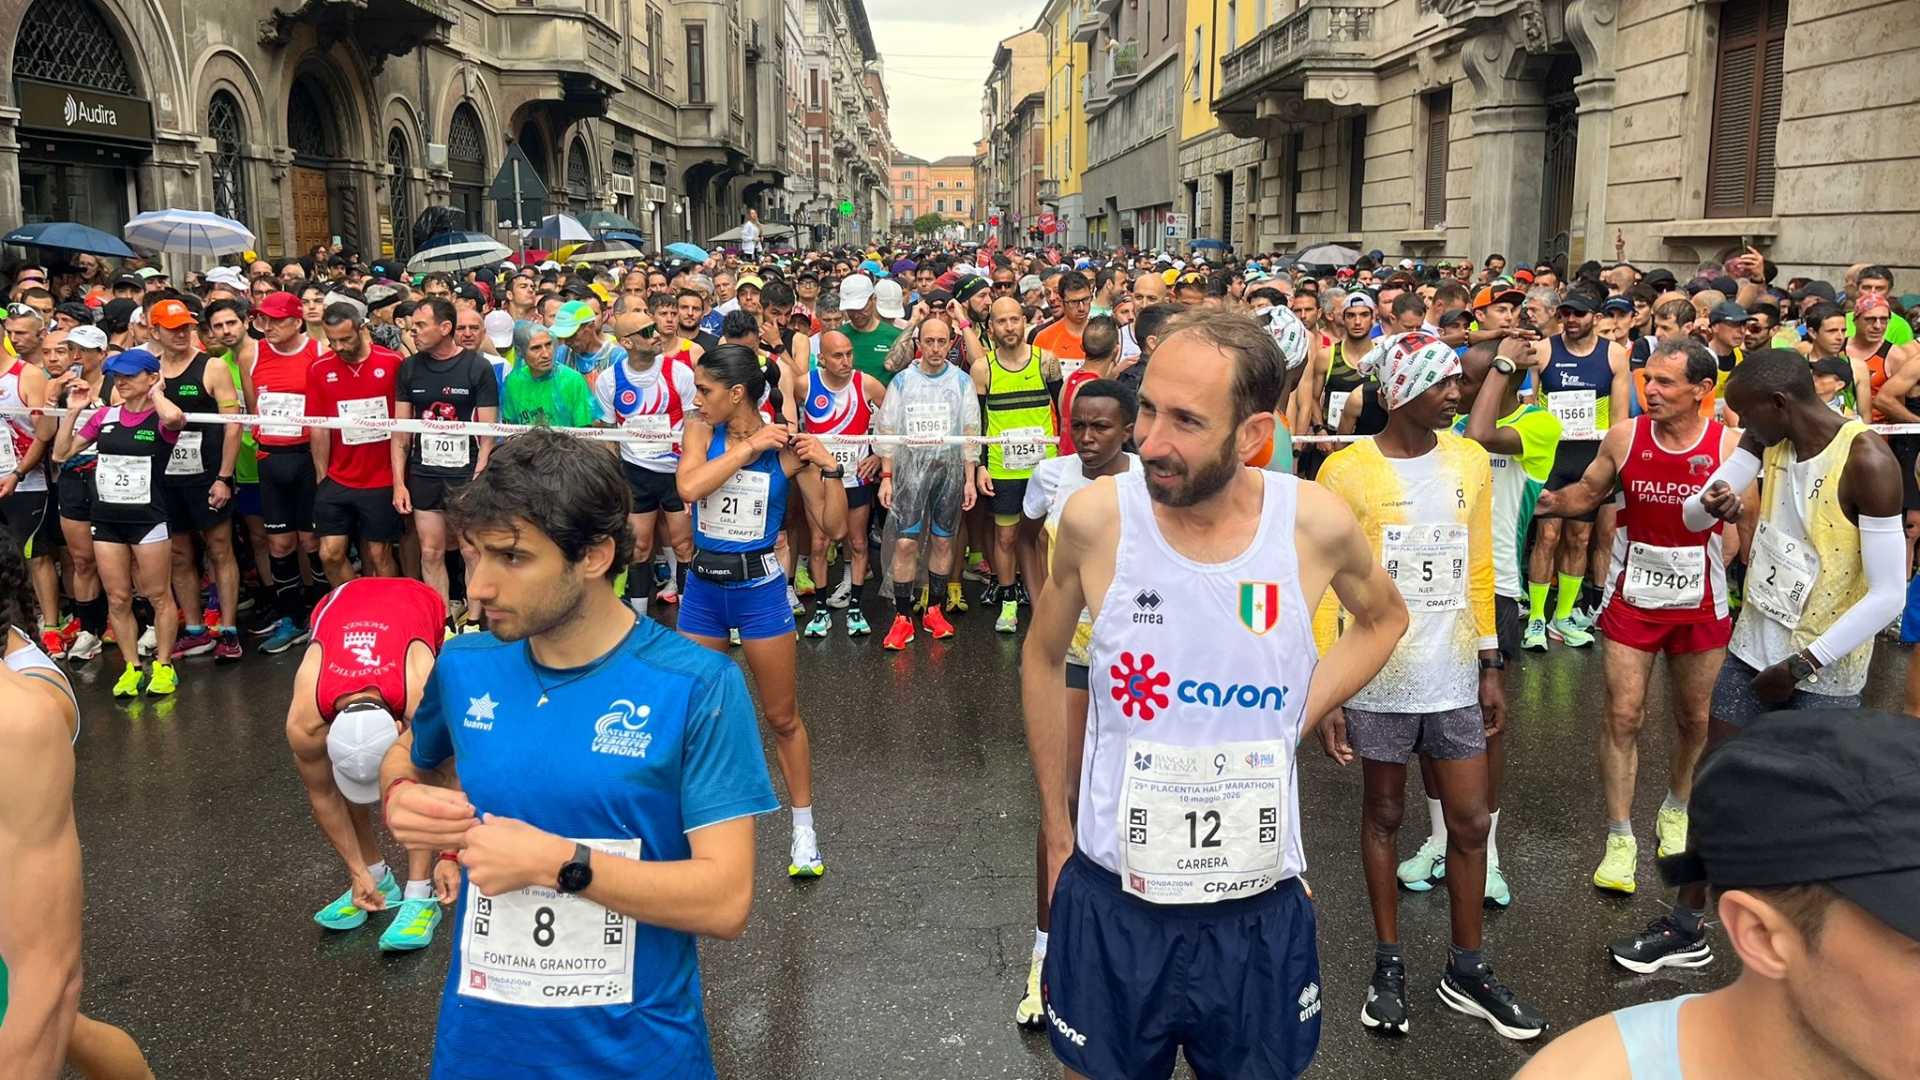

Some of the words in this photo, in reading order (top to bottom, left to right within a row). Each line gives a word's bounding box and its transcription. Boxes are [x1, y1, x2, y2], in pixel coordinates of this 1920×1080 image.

[79, 101, 117, 126] Audira
[1560, 408, 1586, 420] 1566
[915, 420, 940, 433] 1696
[434, 440, 454, 452] 701
[1012, 444, 1036, 456] 1254
[831, 451, 849, 463] 65
[114, 474, 130, 487] 25
[721, 496, 739, 515] 21
[1422, 560, 1433, 582] 5
[1766, 565, 1777, 586] 2
[1645, 570, 1689, 590] 1940
[1426, 599, 1452, 608] CRAFT
[1177, 679, 1289, 711] cason
[463, 717, 493, 732] luanvi
[607, 727, 653, 740] ATLETICA
[591, 743, 647, 759] VERONA
[1151, 785, 1200, 794] PLACENTIA
[1203, 784, 1223, 794] HALF
[1225, 782, 1275, 791] MARATHON
[1191, 795, 1221, 804] maggio
[1185, 810, 1222, 849] 12
[1177, 857, 1229, 870] CARRERA
[1204, 878, 1260, 893] CRAFT
[533, 907, 555, 947] 8
[484, 951, 536, 969] FONTANA
[539, 958, 607, 970] GRANOTTO
[542, 984, 605, 998] CRAFT
